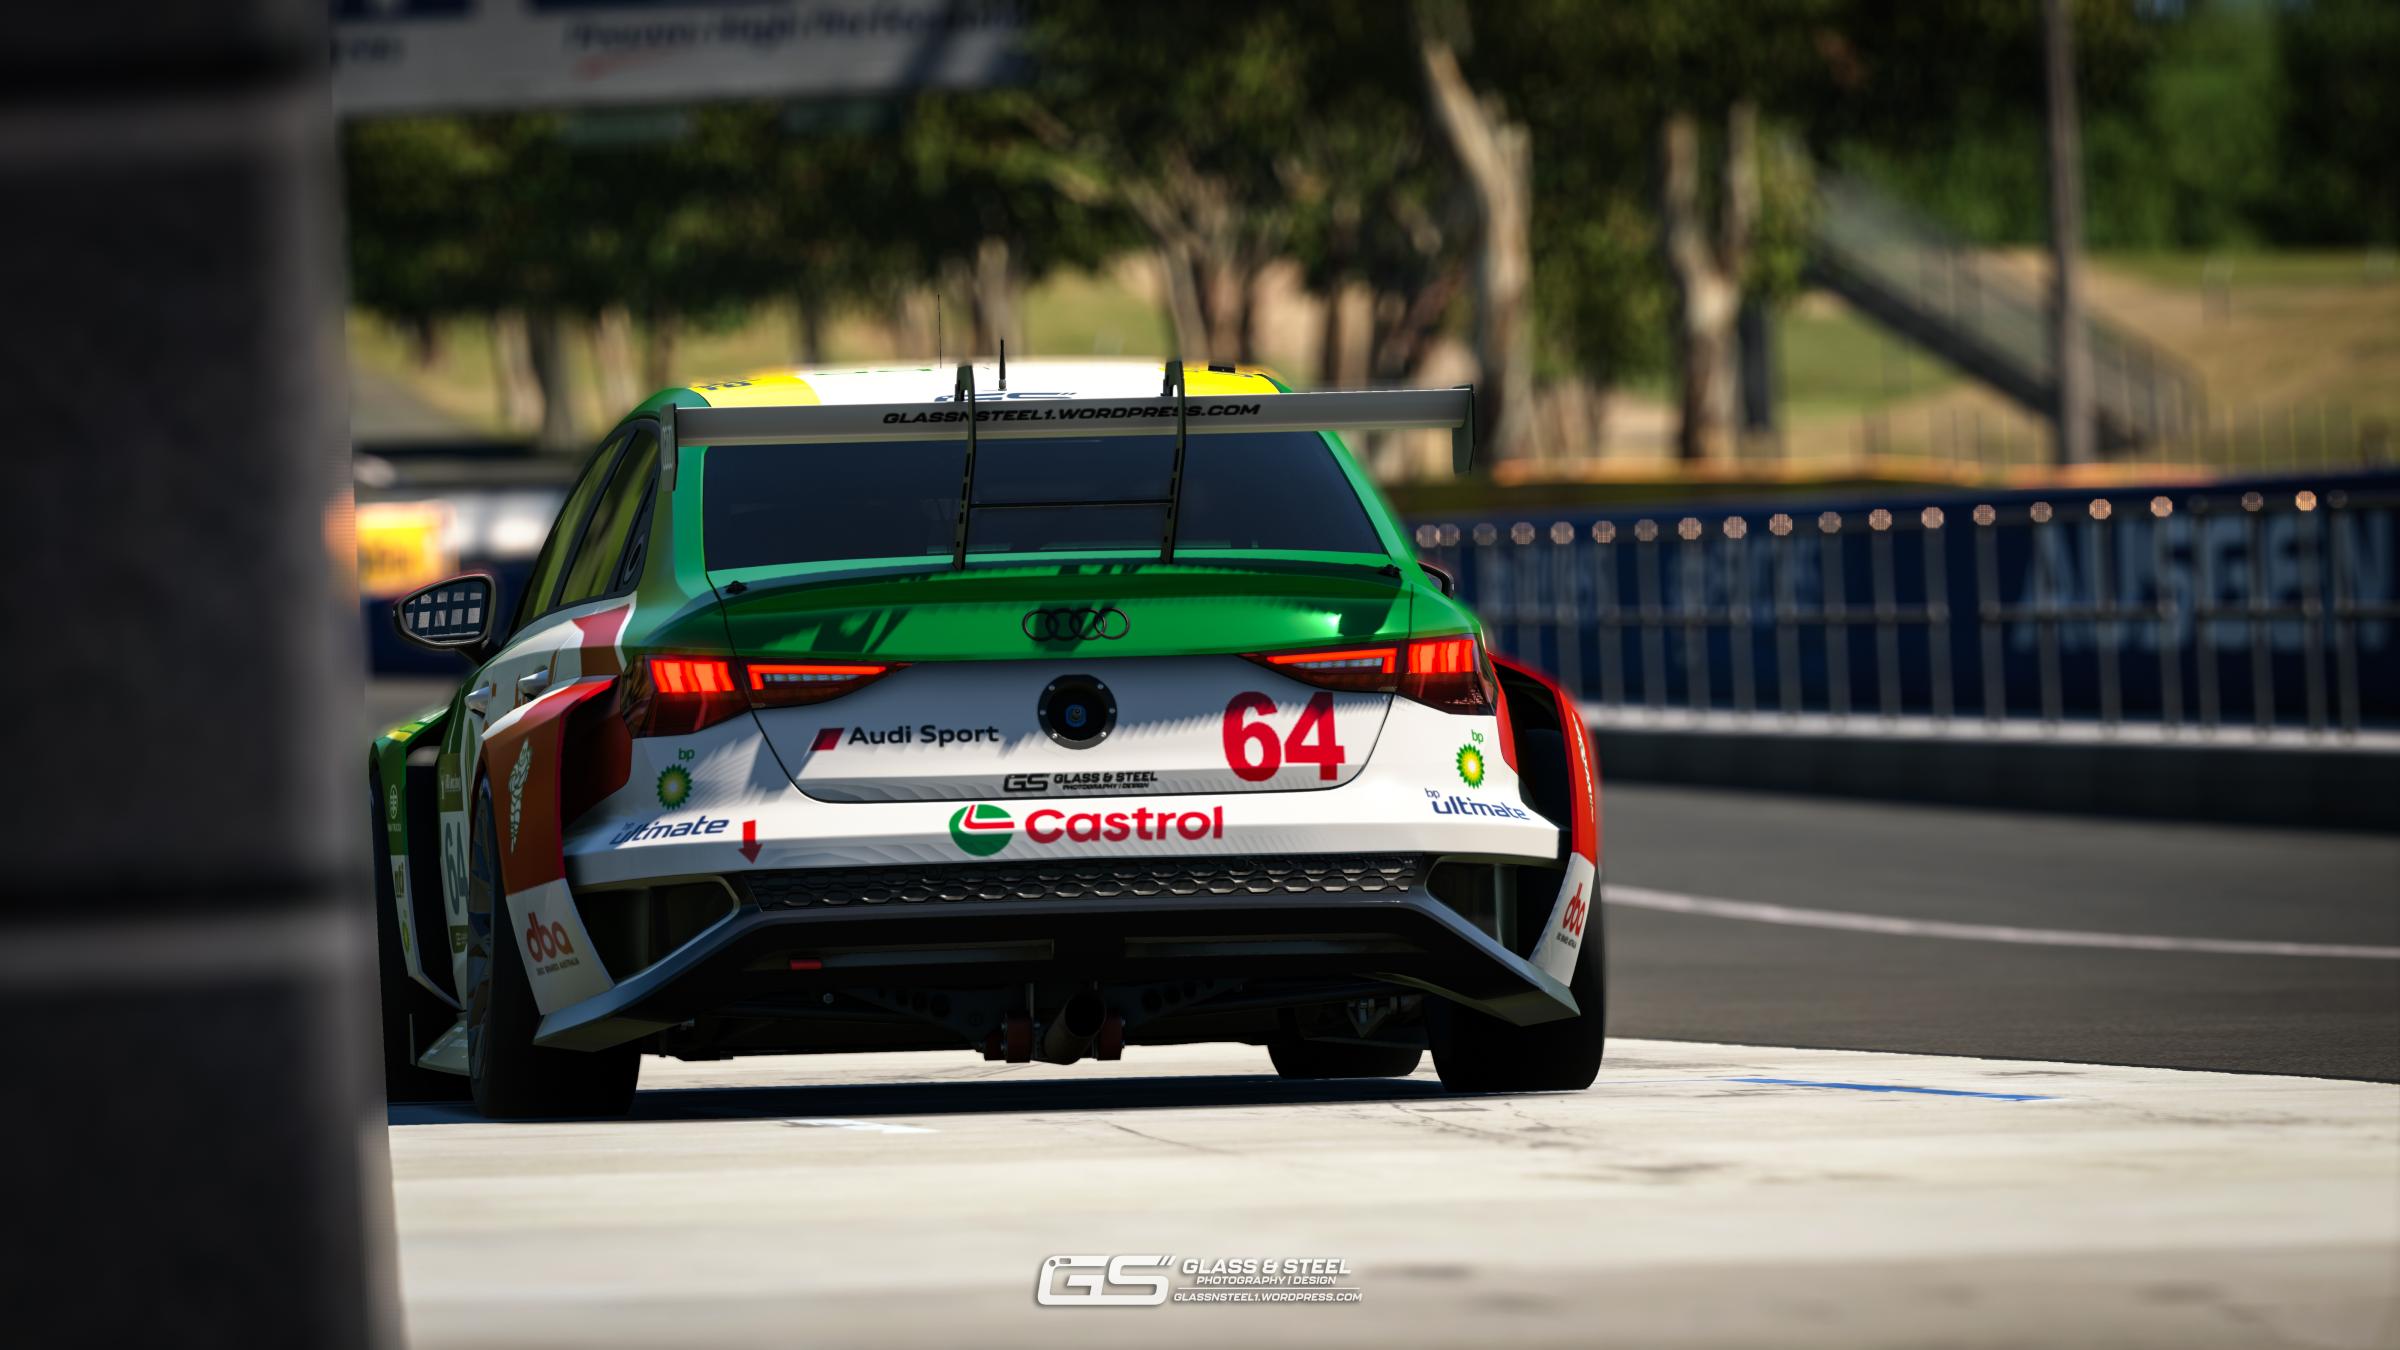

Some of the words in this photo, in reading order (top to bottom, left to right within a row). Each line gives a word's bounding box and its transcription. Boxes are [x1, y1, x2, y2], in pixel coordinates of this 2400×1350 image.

[848, 726, 911, 745] Audi
[920, 725, 999, 747] Sport
[1222, 691, 1346, 782] 64
[1471, 729, 1484, 744] bp
[678, 748, 695, 762] bp
[1054, 773, 1100, 784] GLASS
[1102, 773, 1113, 783] &
[1115, 771, 1158, 782] STEEL
[1424, 787, 1440, 799] bp
[1432, 796, 1531, 820] ultimate
[609, 815, 729, 845] ultimate
[1025, 806, 1223, 844] Castrol
[1563, 883, 1585, 937] dba
[526, 912, 574, 963] dba
